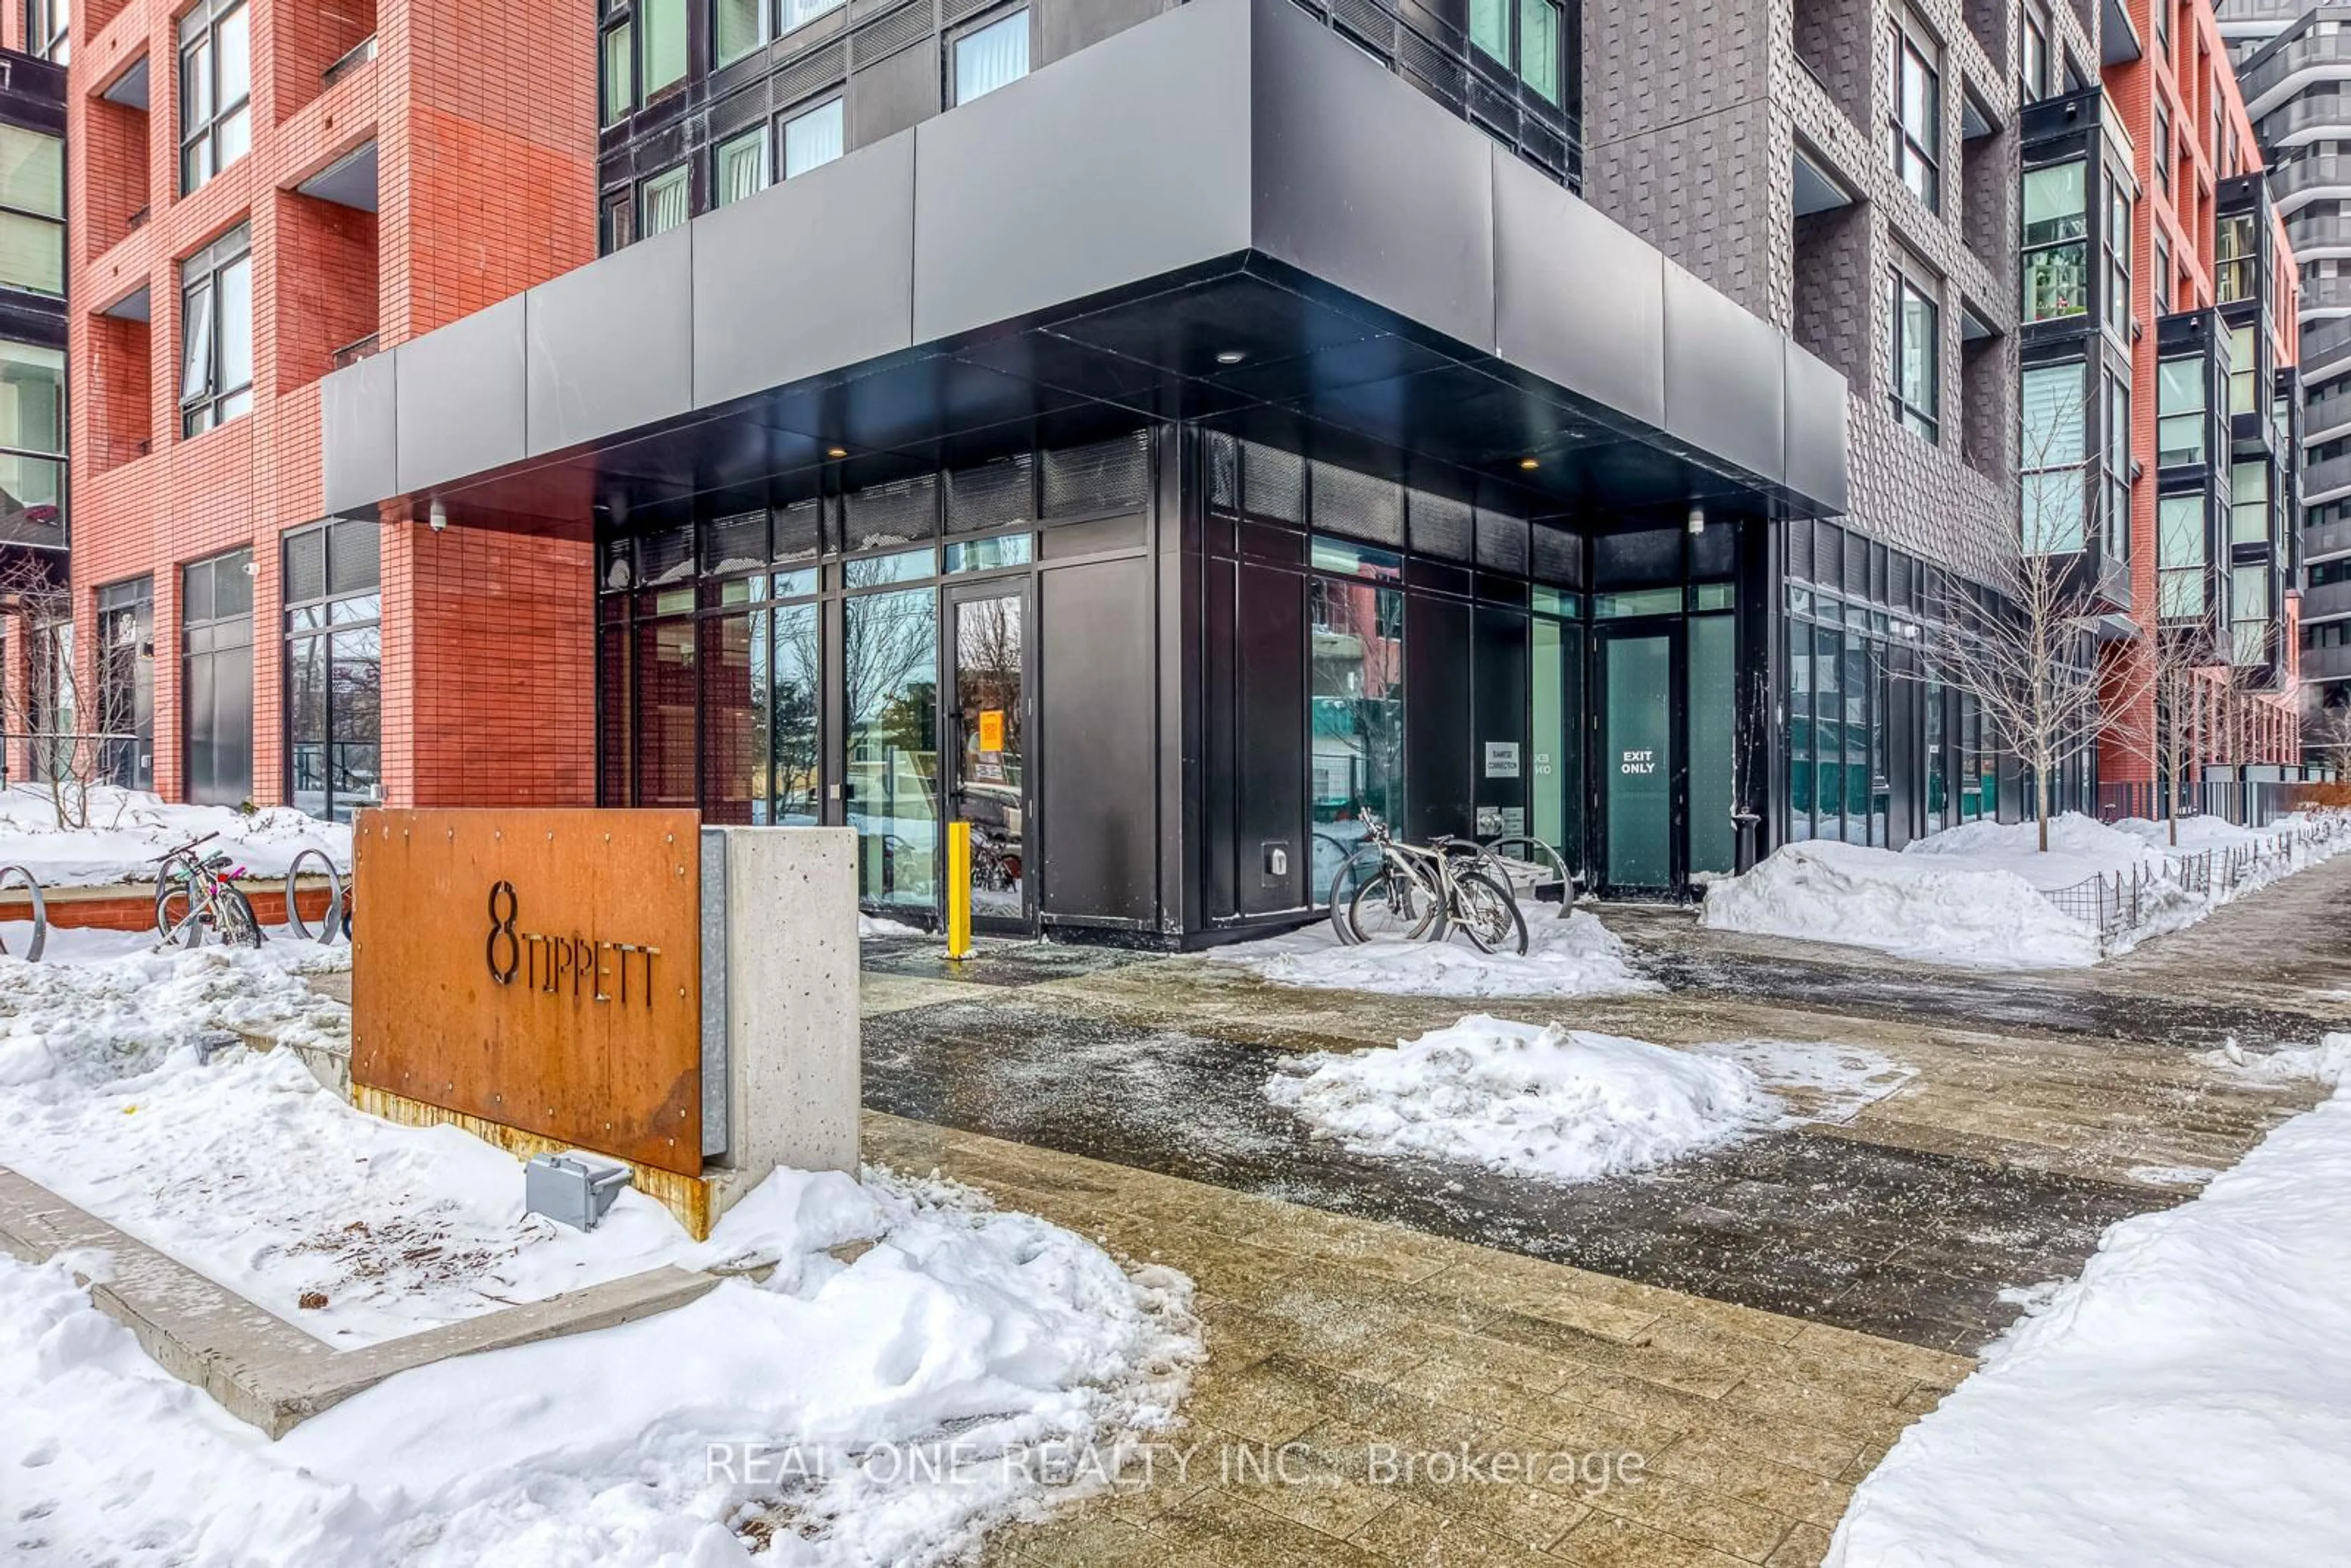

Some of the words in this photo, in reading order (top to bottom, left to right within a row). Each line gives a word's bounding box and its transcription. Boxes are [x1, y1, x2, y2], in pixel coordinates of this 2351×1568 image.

[1623, 751, 1652, 762] EXIT
[1621, 763, 1655, 774] ONLY
[486, 880, 520, 985] 8
[522, 932, 661, 1008] TIPPETT
